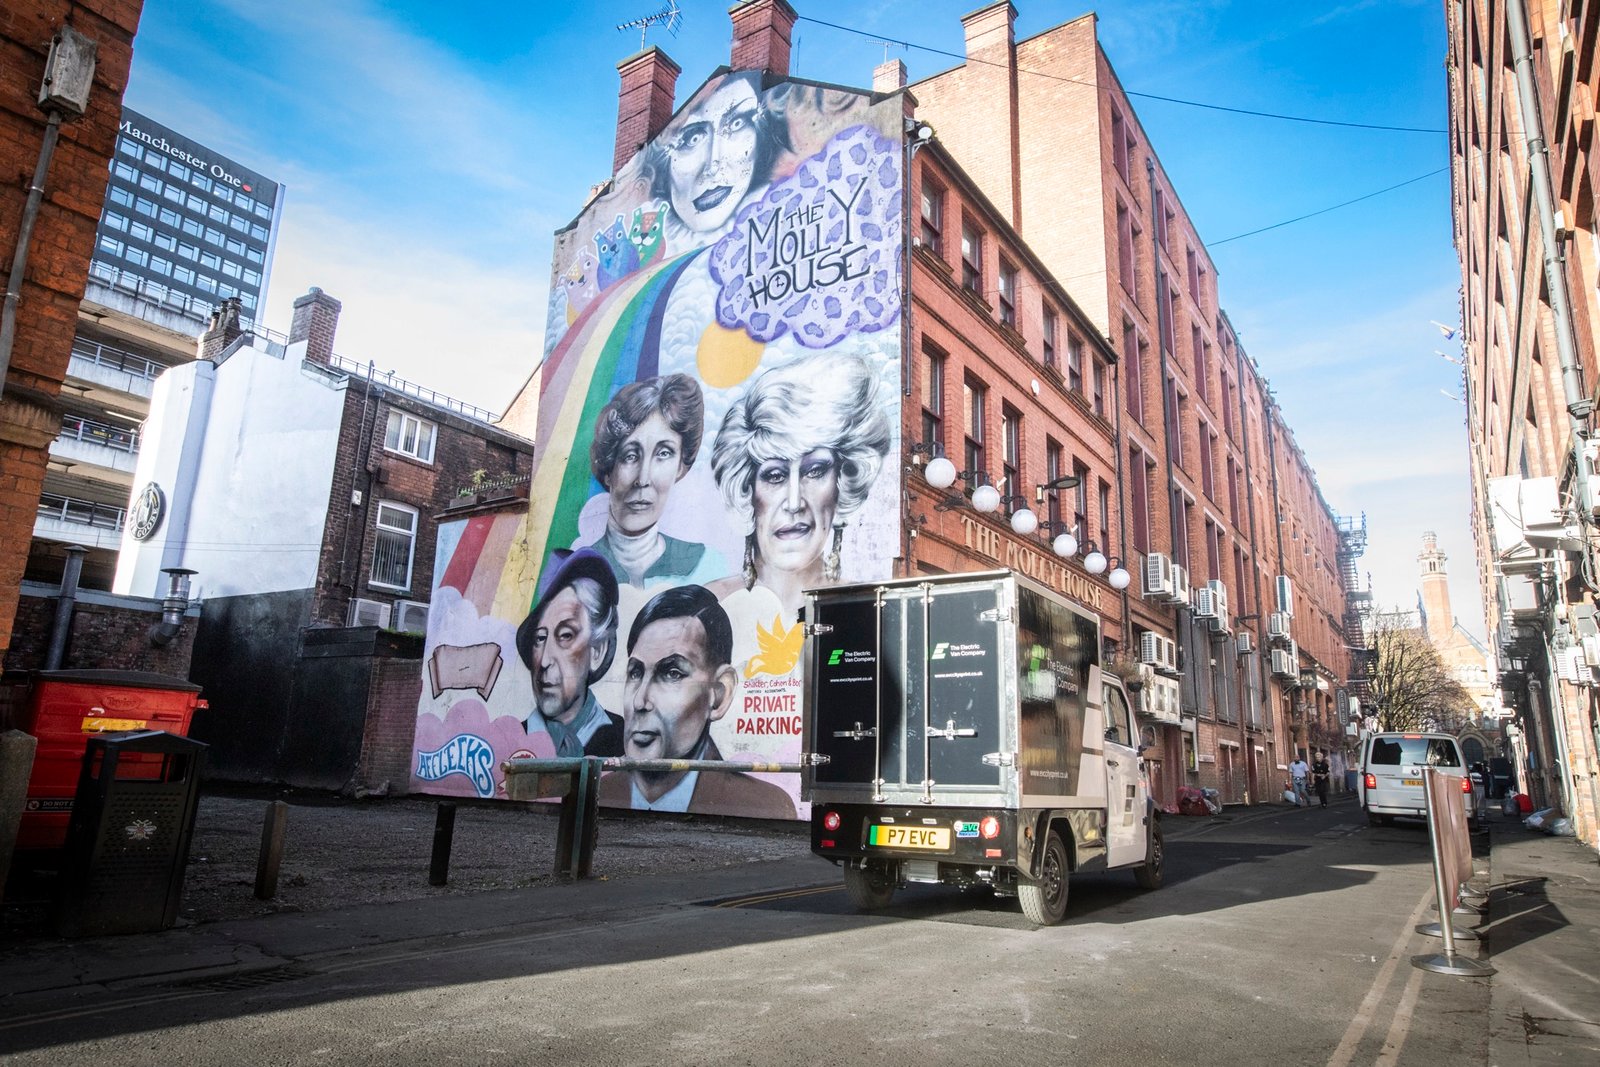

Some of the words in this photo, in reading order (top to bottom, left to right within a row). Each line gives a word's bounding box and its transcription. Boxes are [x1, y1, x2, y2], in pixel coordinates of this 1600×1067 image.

[120, 120, 208, 171] Manchester
[210, 164, 241, 188] One
[745, 176, 868, 278] MOLLY
[786, 204, 824, 229] THE
[748, 244, 871, 309] HOUSE
[961, 515, 1001, 562] THE
[1006, 539, 1058, 589] MOLLY
[1060, 566, 1103, 610] HOUSE
[744, 694, 796, 713] PRIVATE
[736, 716, 802, 736] PARKING
[418, 735, 492, 796] AFFLECKS
[887, 829, 906, 844] P7
[909, 830, 937, 846] EVC
[963, 823, 978, 832] EVC
